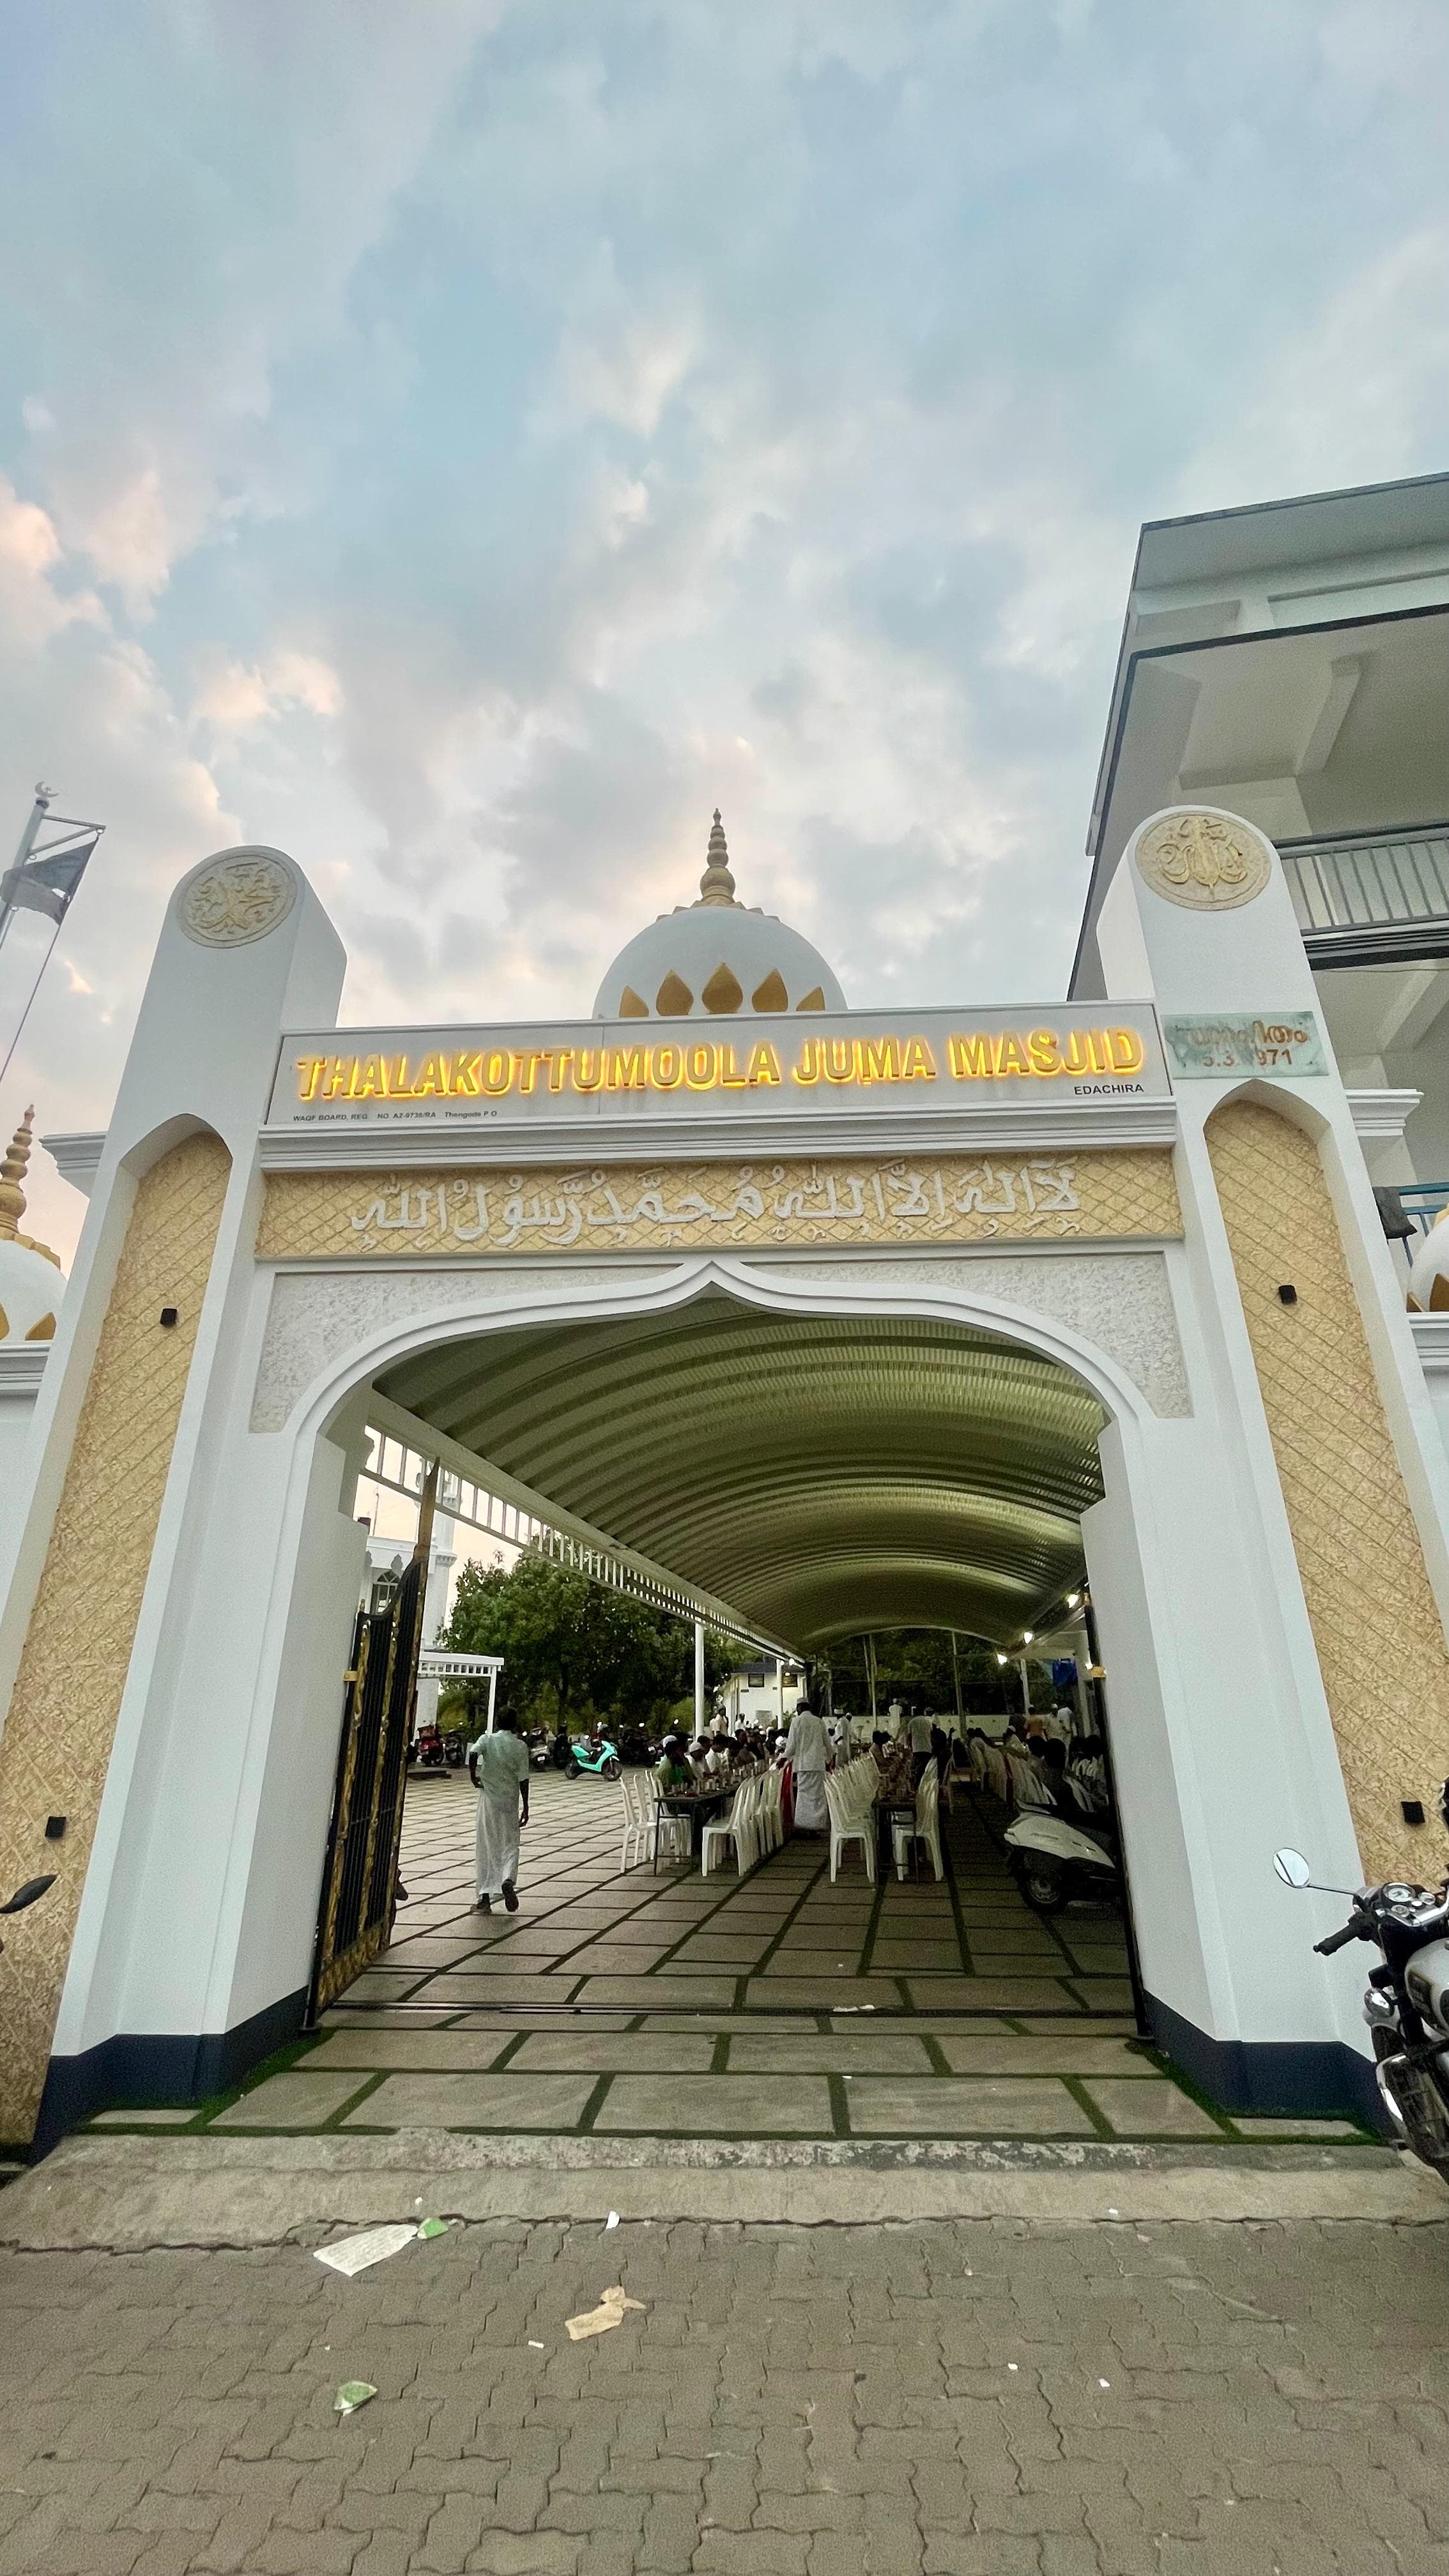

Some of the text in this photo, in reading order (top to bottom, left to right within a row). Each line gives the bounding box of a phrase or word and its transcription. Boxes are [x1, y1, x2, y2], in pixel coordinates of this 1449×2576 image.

[298, 1039, 780, 1100] THALAKOTTUMOOLA
[792, 1034, 937, 1084] JUMA
[949, 1026, 1143, 1077] MASJID
[1074, 1083, 1144, 1095] EDACHIRA
